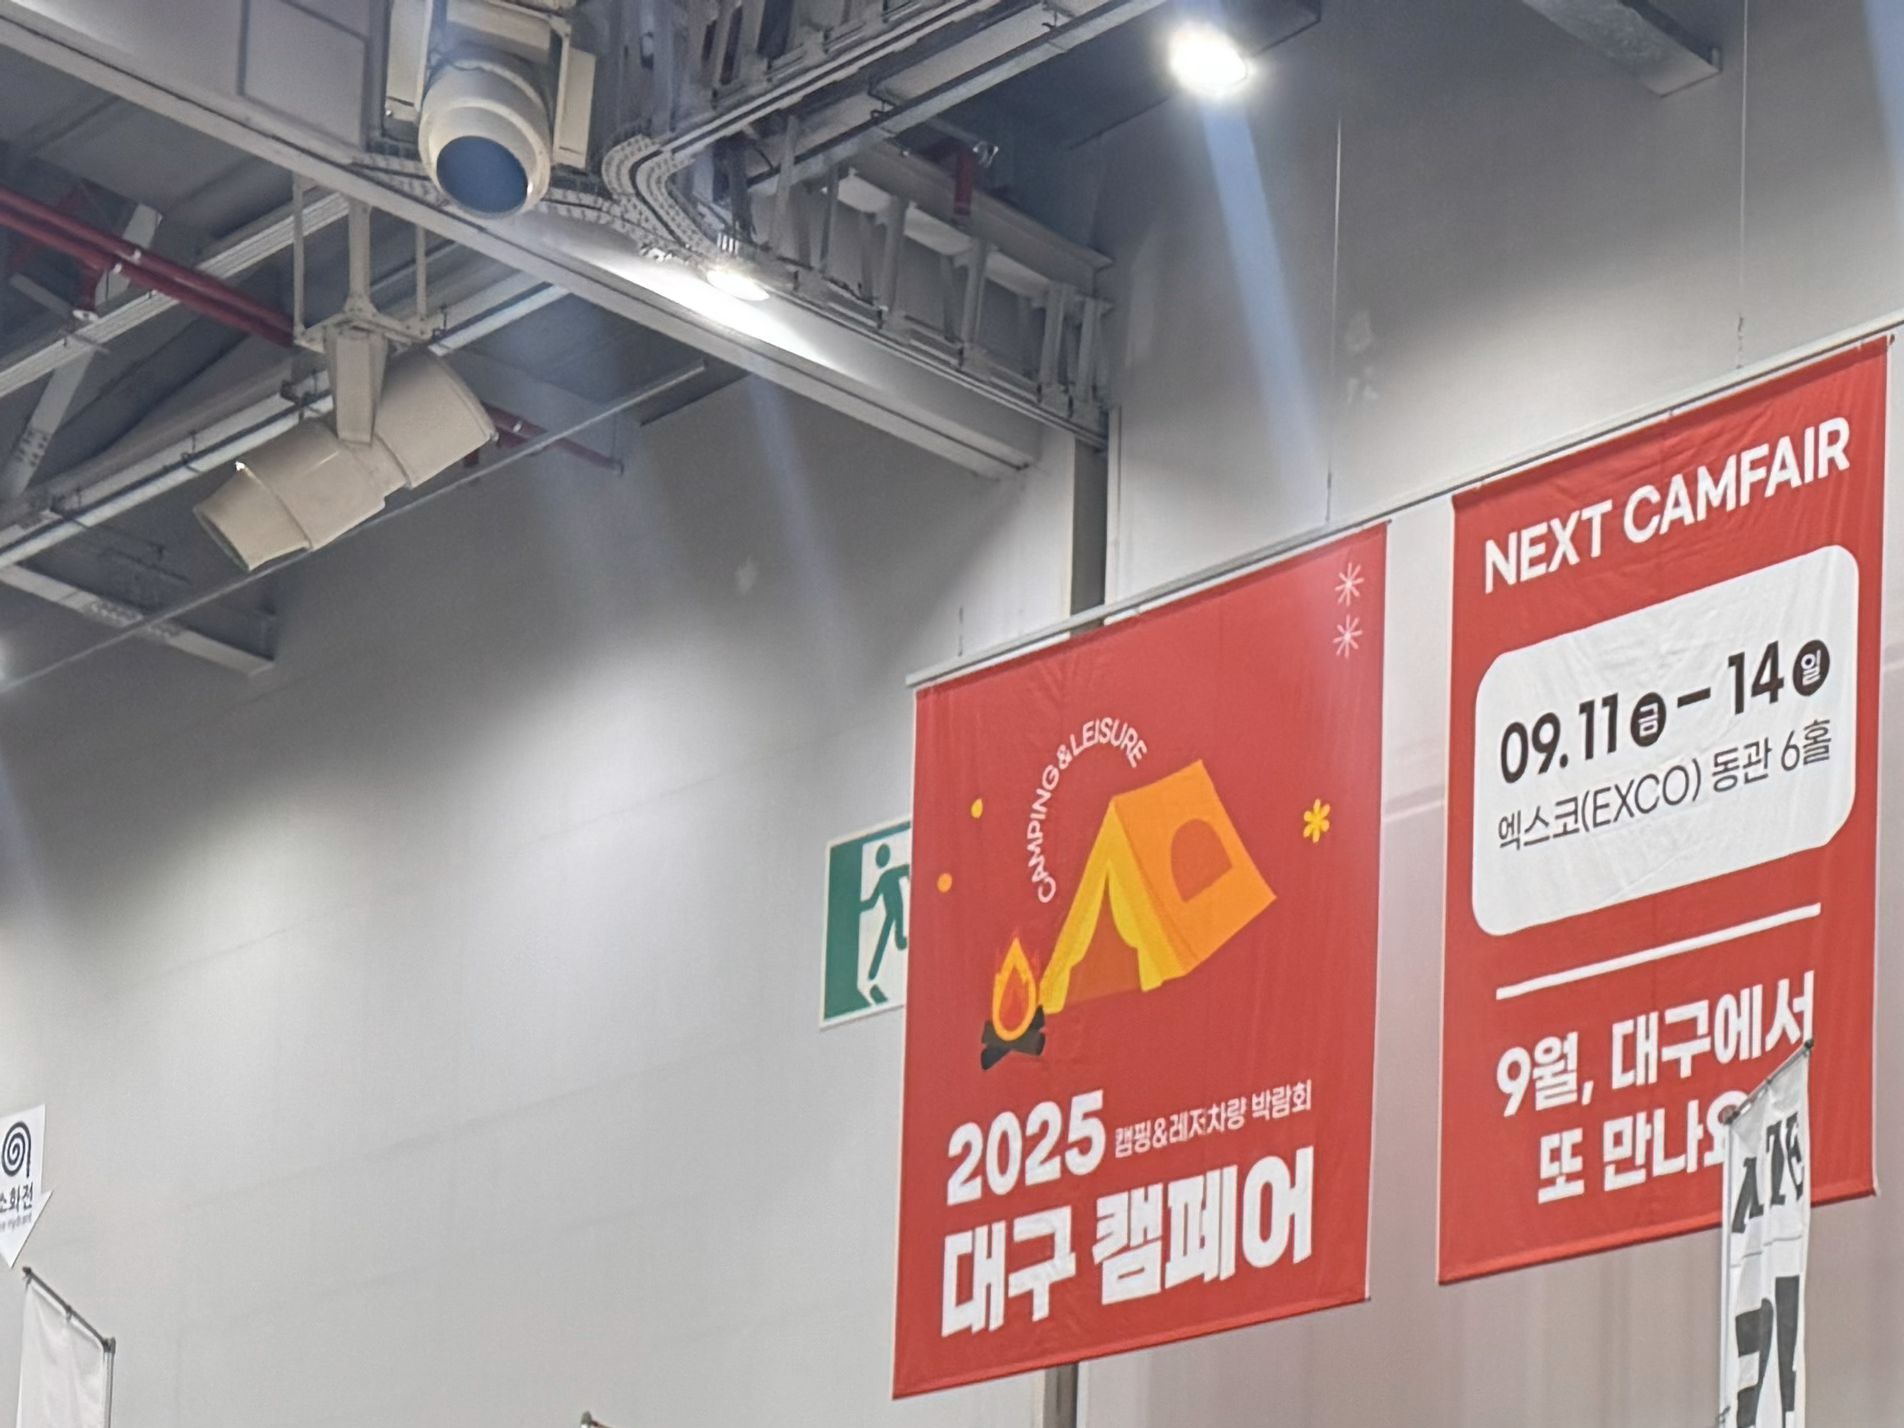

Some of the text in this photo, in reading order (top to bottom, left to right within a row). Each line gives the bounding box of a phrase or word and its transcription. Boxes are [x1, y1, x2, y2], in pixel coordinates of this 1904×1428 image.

[1482, 416, 1851, 595] NEXT CAMFAIR
[1498, 719, 1832, 851] 엑스코(EXCO) 동관 6홀
[1496, 970, 1816, 1118] 9월, 대구에서
[945, 1089, 1108, 1205] 2025
[1114, 1078, 1312, 1159] 캠핑&레저차량 박람회
[1538, 1089, 1753, 1205] 또 만나요
[940, 1145, 1315, 1339] 대구 캠페어
